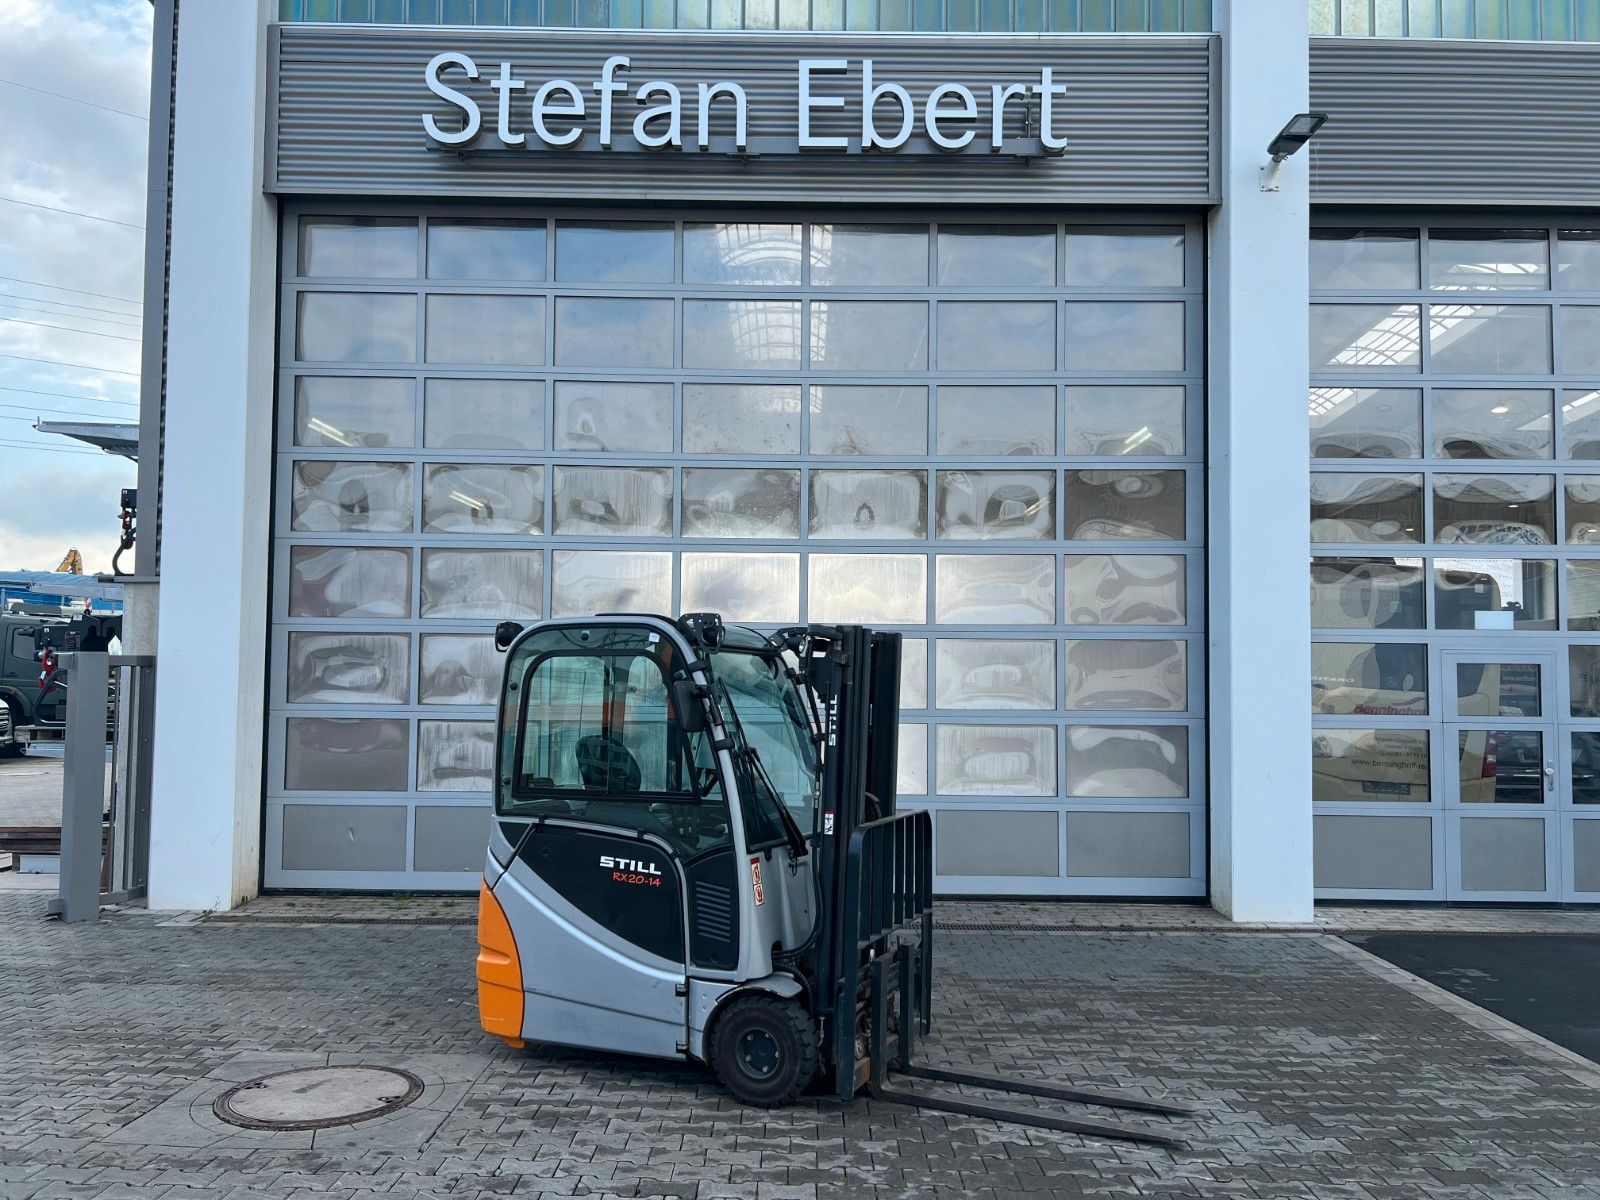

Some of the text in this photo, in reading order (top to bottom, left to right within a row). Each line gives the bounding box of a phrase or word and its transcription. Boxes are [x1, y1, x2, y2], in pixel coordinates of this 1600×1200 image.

[422, 52, 1068, 152] Stefan Ebert
[828, 694, 838, 746] STILL
[600, 855, 662, 875] STILL
[612, 871, 662, 887] RX20-14
